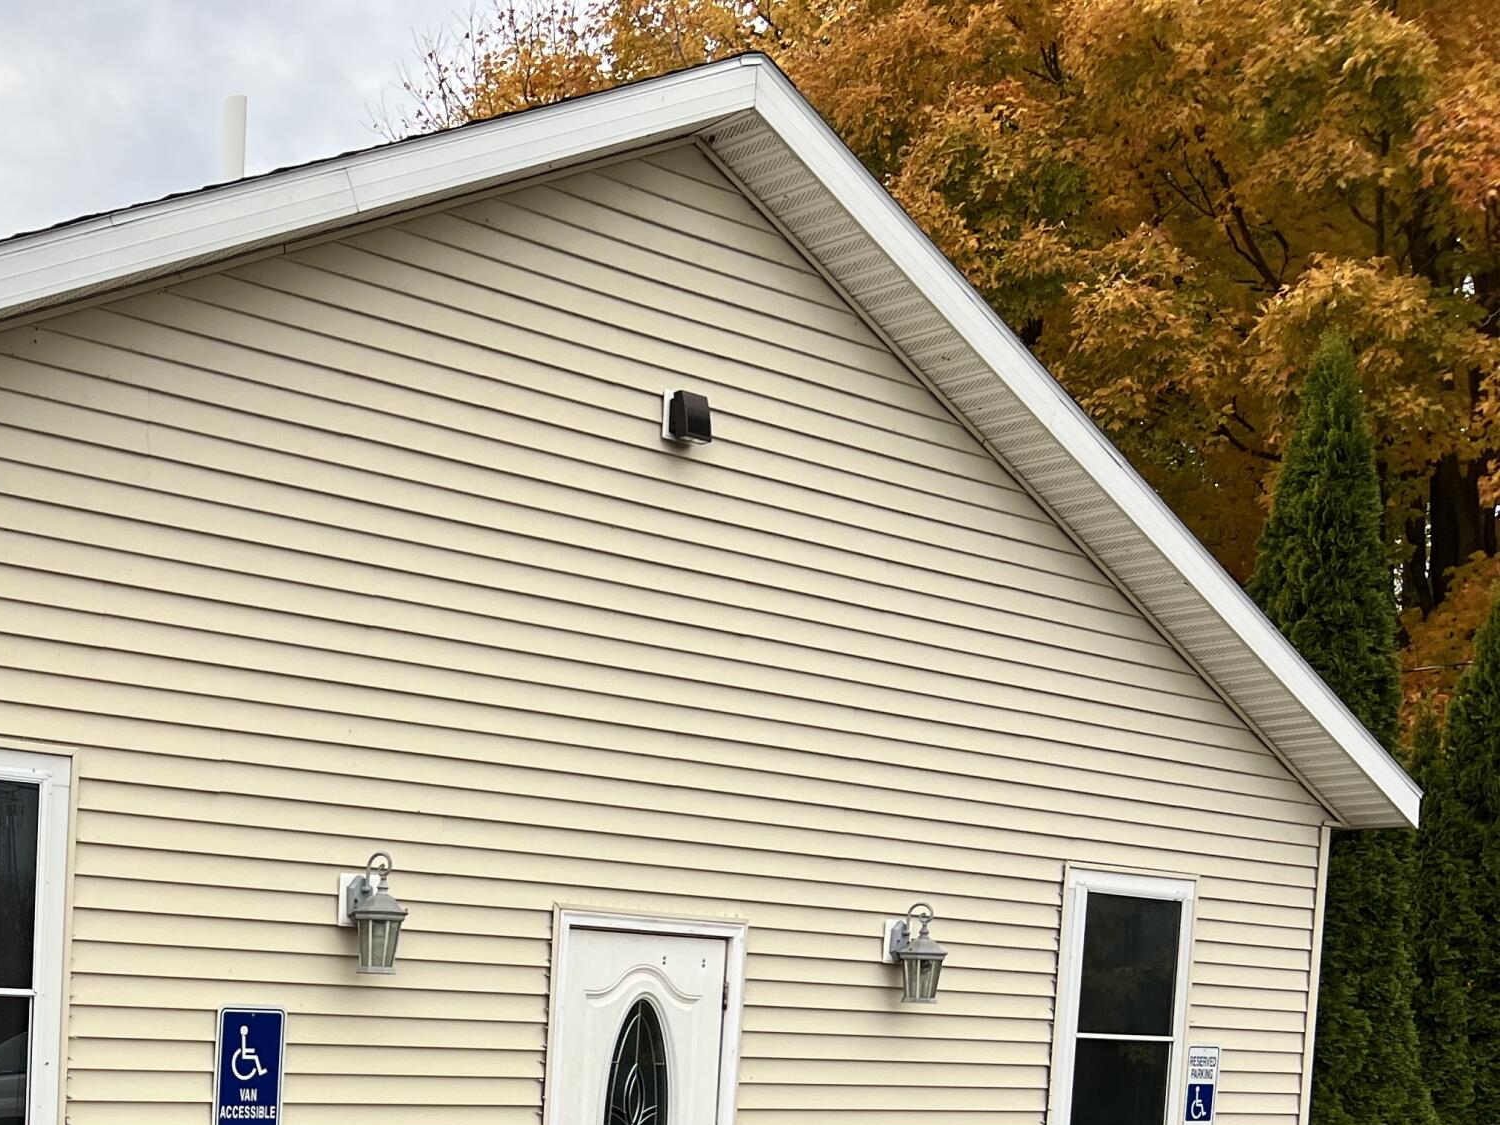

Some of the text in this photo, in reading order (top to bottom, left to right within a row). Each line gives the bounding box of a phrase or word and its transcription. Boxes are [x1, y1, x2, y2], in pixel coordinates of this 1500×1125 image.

[1190, 1056, 1216, 1067] RESERVED
[1191, 1069, 1213, 1079] PARKING
[240, 1088, 257, 1101] VAN
[220, 1105, 275, 1118] ACCESSIBLE
